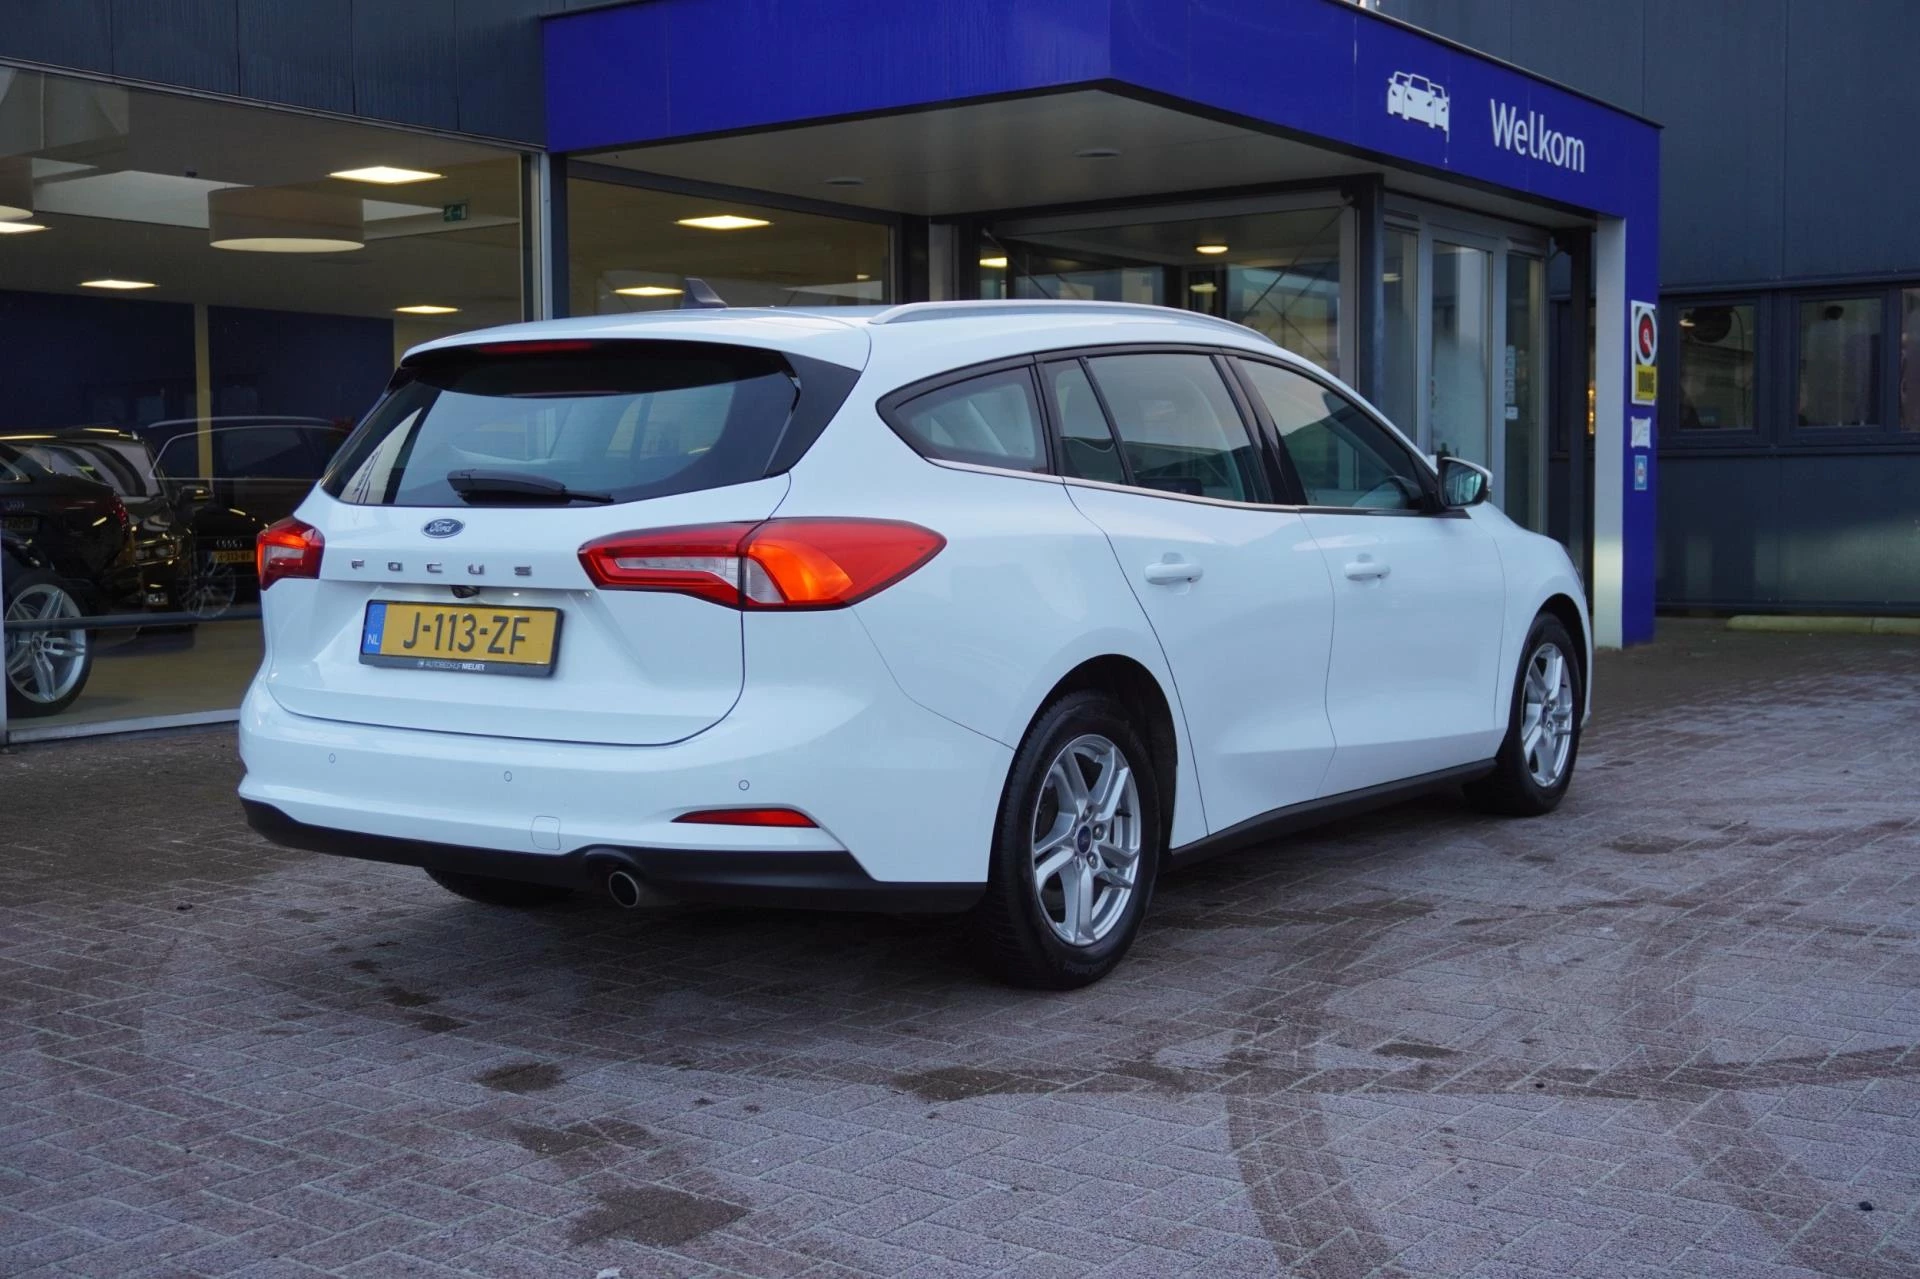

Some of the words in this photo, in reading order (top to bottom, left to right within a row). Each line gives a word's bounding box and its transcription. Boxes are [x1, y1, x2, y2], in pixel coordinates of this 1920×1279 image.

[1490, 98, 1586, 173] Welkom
[429, 520, 456, 533] Ford
[351, 559, 532, 577] FOCUS
[367, 634, 379, 645] NL
[402, 611, 530, 655] J-113-ZF
